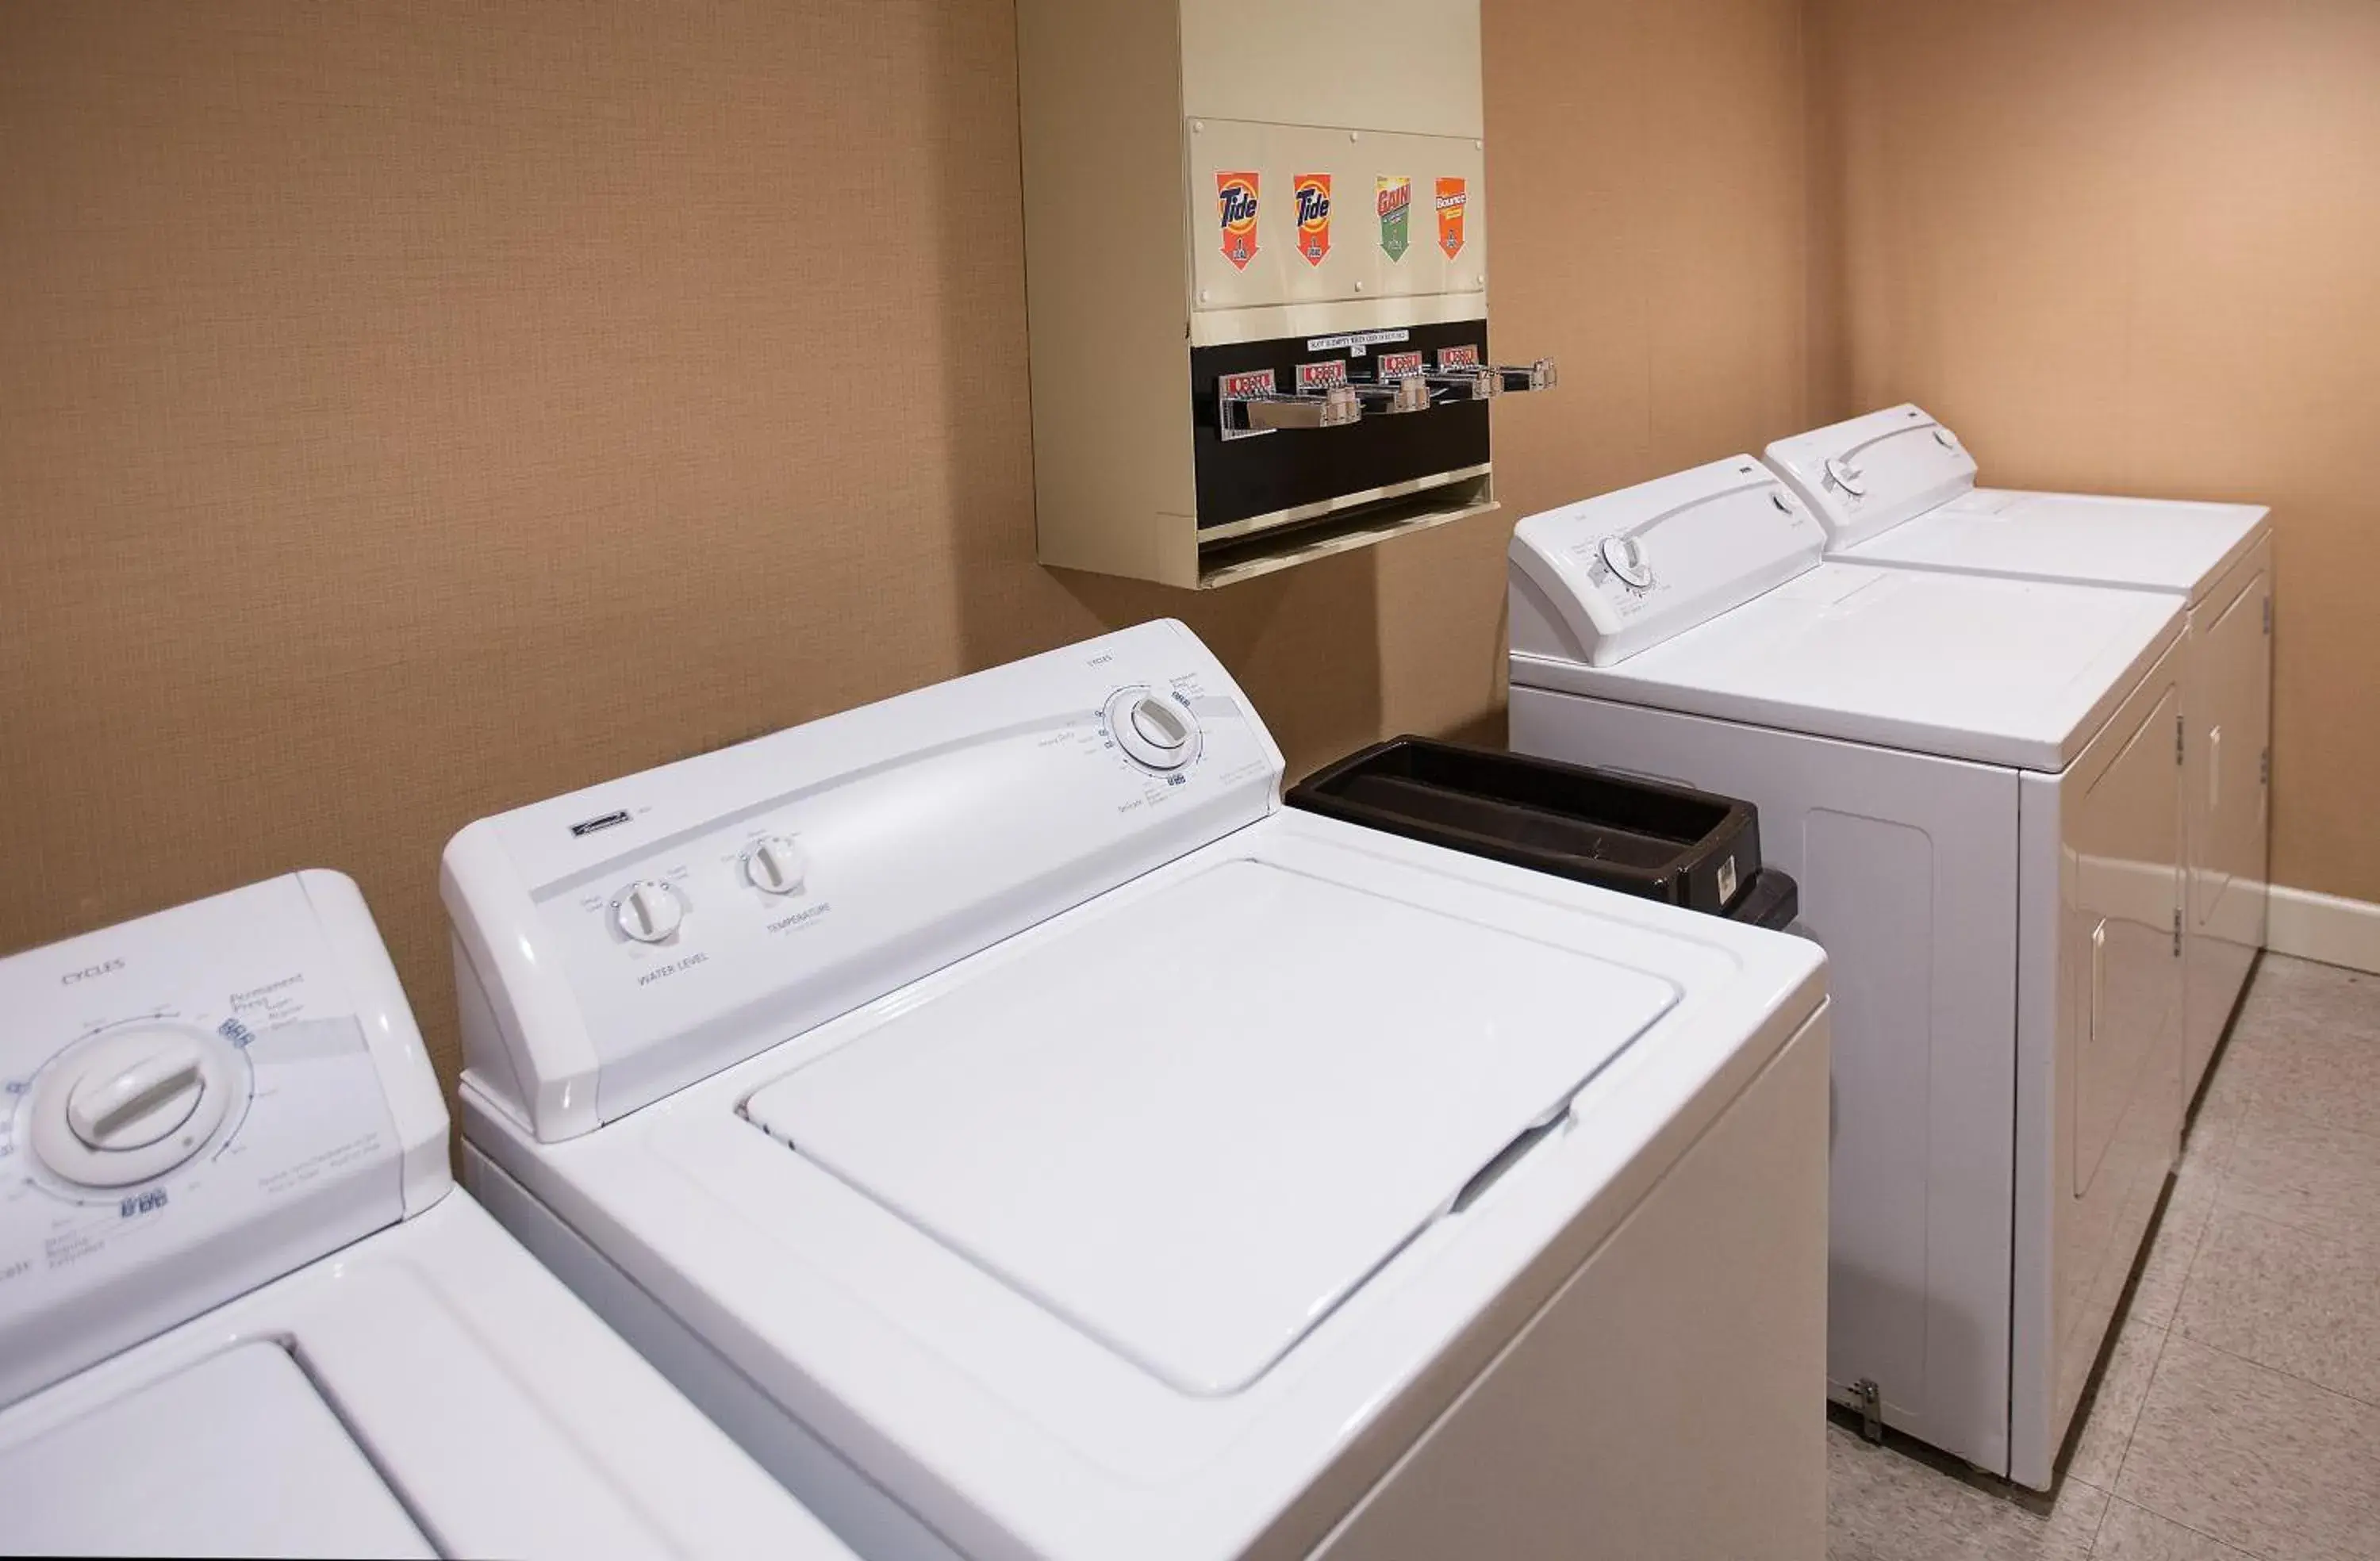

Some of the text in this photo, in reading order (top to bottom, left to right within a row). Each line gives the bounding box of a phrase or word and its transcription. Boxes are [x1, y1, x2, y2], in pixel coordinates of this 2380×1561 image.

[1219, 186, 1257, 228] Tide
[1296, 188, 1330, 227] Tide
[1377, 184, 1411, 217] GAIN
[1436, 194, 1467, 209] Bounce
[766, 903, 831, 934] TEMPERATURE
[62, 957, 125, 985] CYCLES
[637, 952, 710, 987] WATER LEVEL
